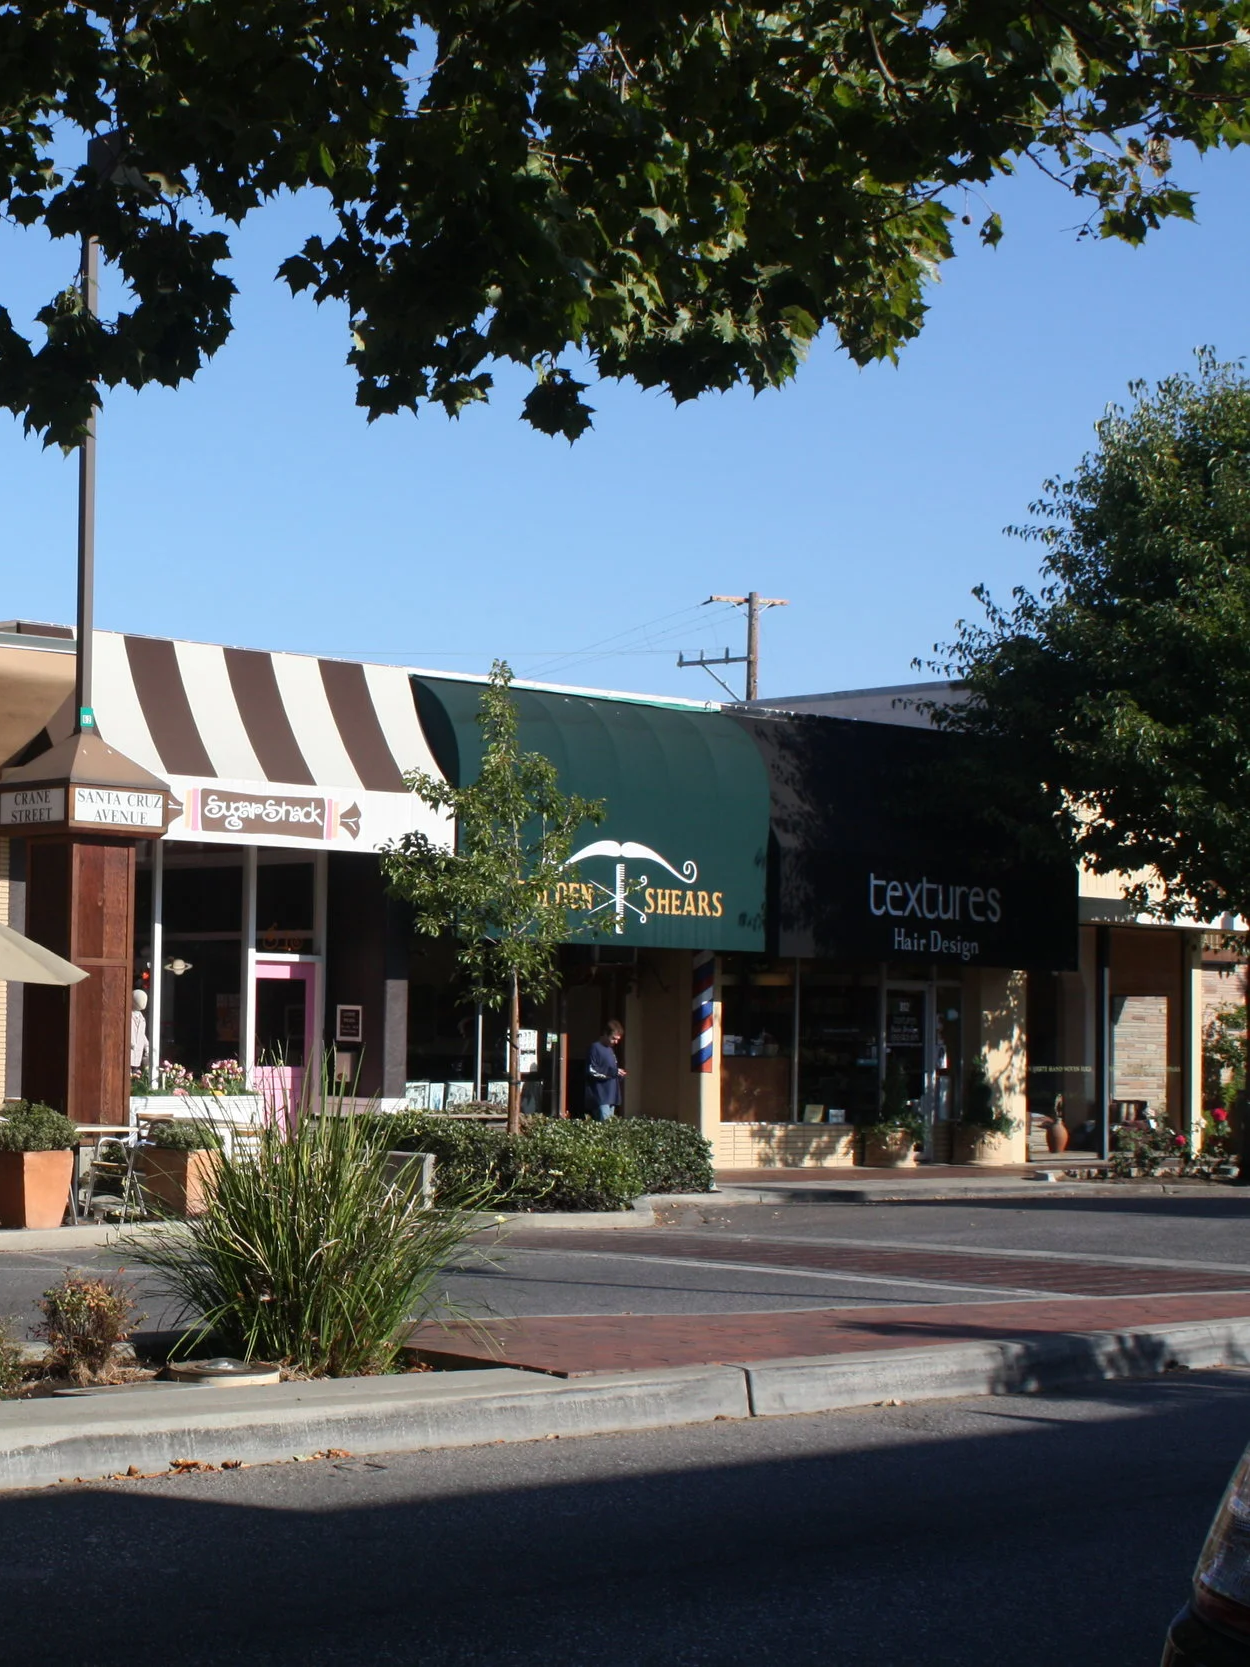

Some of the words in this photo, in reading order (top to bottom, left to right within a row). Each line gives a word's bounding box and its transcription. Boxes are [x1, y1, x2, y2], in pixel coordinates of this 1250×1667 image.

[14, 790, 51, 806] CRANE
[77, 789, 122, 806] SANTA
[127, 793, 163, 809] CRUZ
[11, 807, 53, 823] STREET
[93, 808, 148, 825] AVENUE
[644, 887, 724, 918] SHEARS
[869, 872, 1002, 923] textures
[894, 927, 927, 951] Hair
[930, 930, 980, 961] Design
